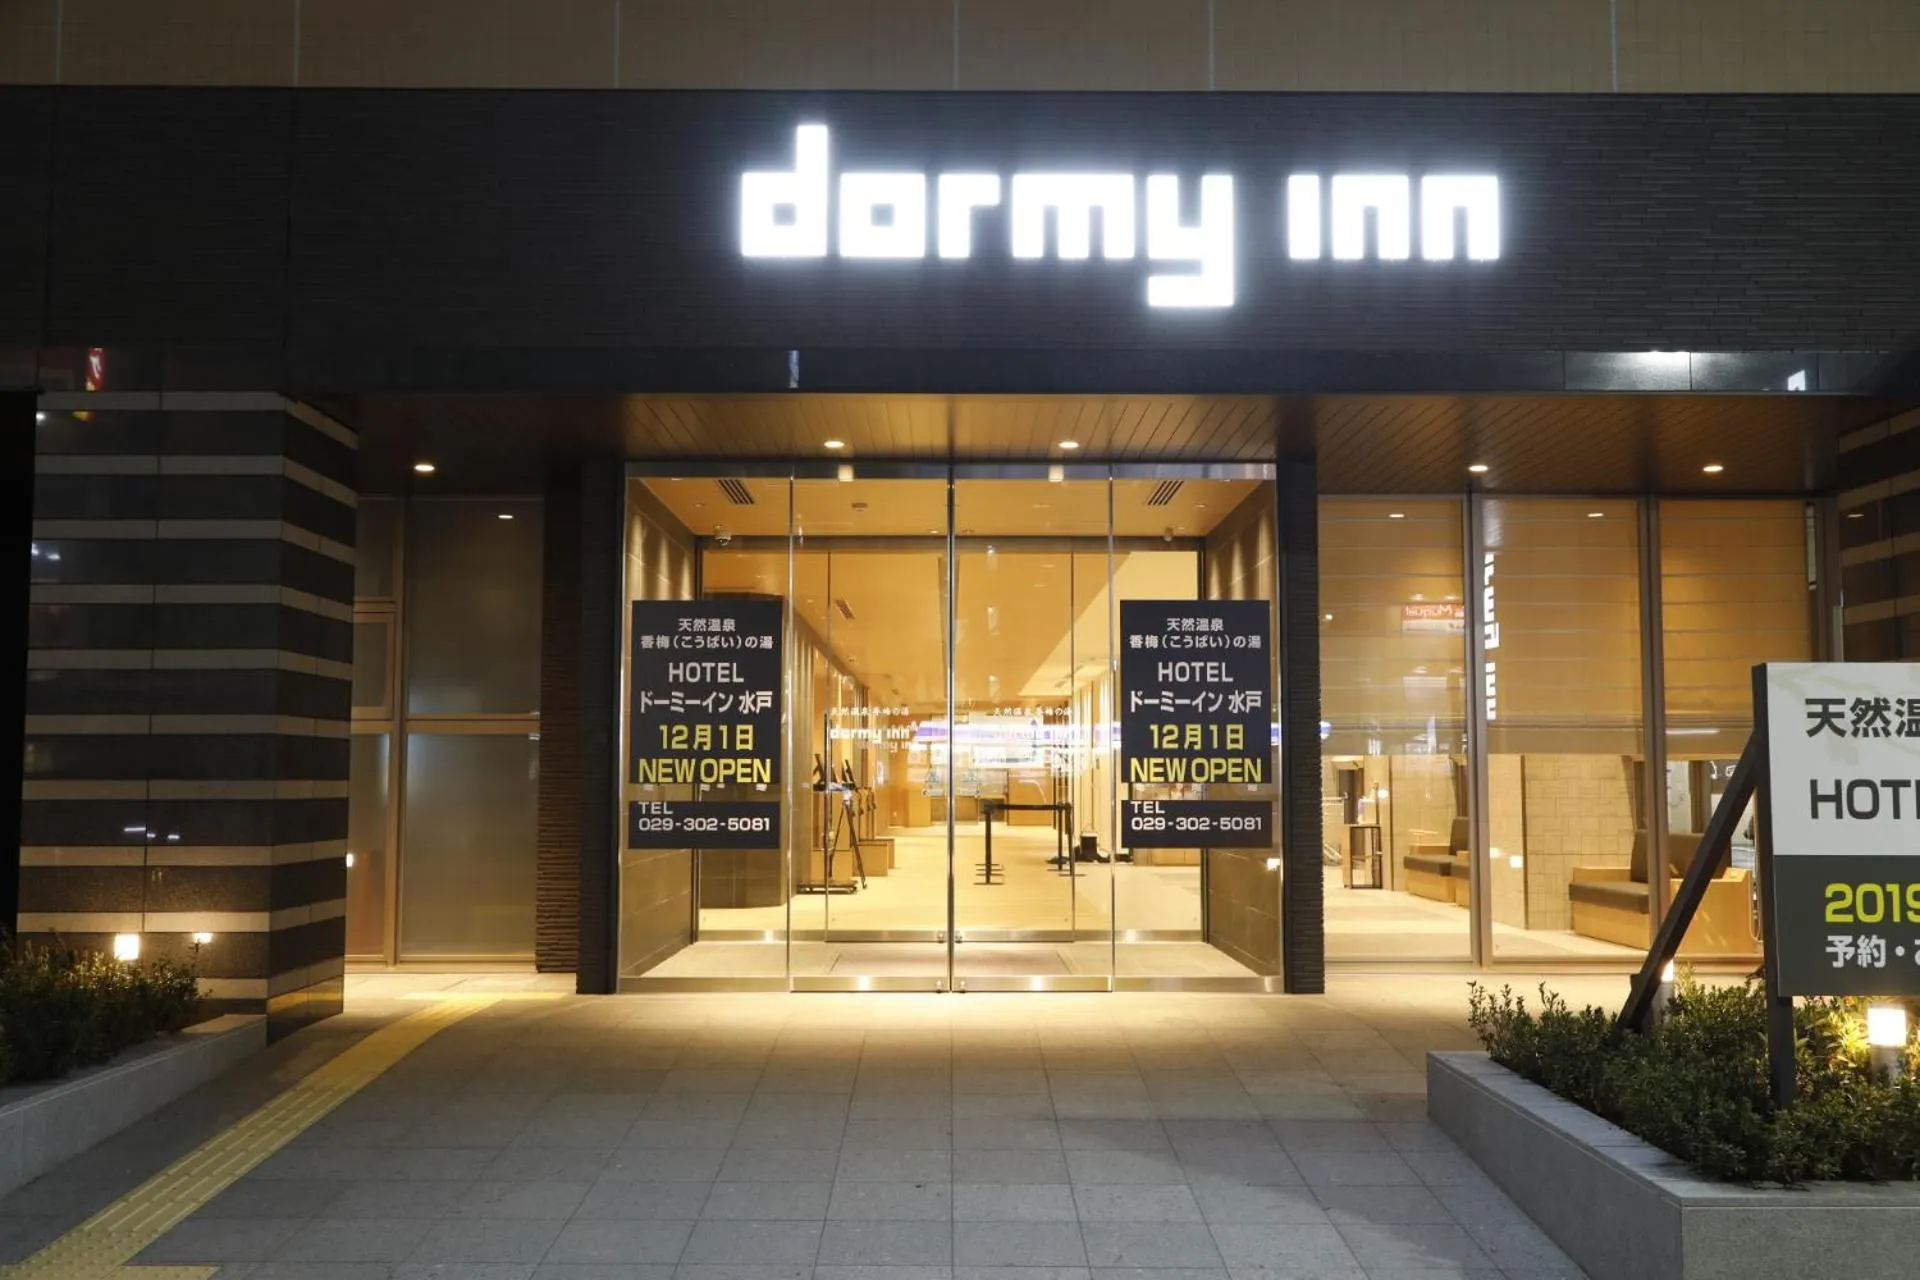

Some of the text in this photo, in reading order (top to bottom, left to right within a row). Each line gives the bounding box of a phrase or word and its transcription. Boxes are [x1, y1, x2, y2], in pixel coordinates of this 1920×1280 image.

[740, 124, 1501, 307] dormy inn
[678, 618, 736, 632] 天然温泉
[1166, 618, 1224, 632] 天然温泉
[668, 662, 744, 683] HOTEL
[1158, 661, 1234, 682] HOTEL
[640, 691, 773, 714] ドーミーイン 水戸
[1130, 690, 1263, 714] ドーミーイン 水戸
[1804, 697, 1920, 738] 天然温
[659, 724, 754, 750] 12月1日
[1150, 724, 1244, 750] 12月1日
[639, 758, 771, 783] NEW OPEN
[1130, 758, 1262, 783] NEW OPEN
[638, 802, 674, 814] TEL
[1130, 801, 1166, 814] TEL
[1809, 778, 1920, 820] HOT
[638, 817, 770, 831] 029-302-5081
[1131, 817, 1262, 831] 029-302-5081
[1825, 934, 1920, 968] 予約・
